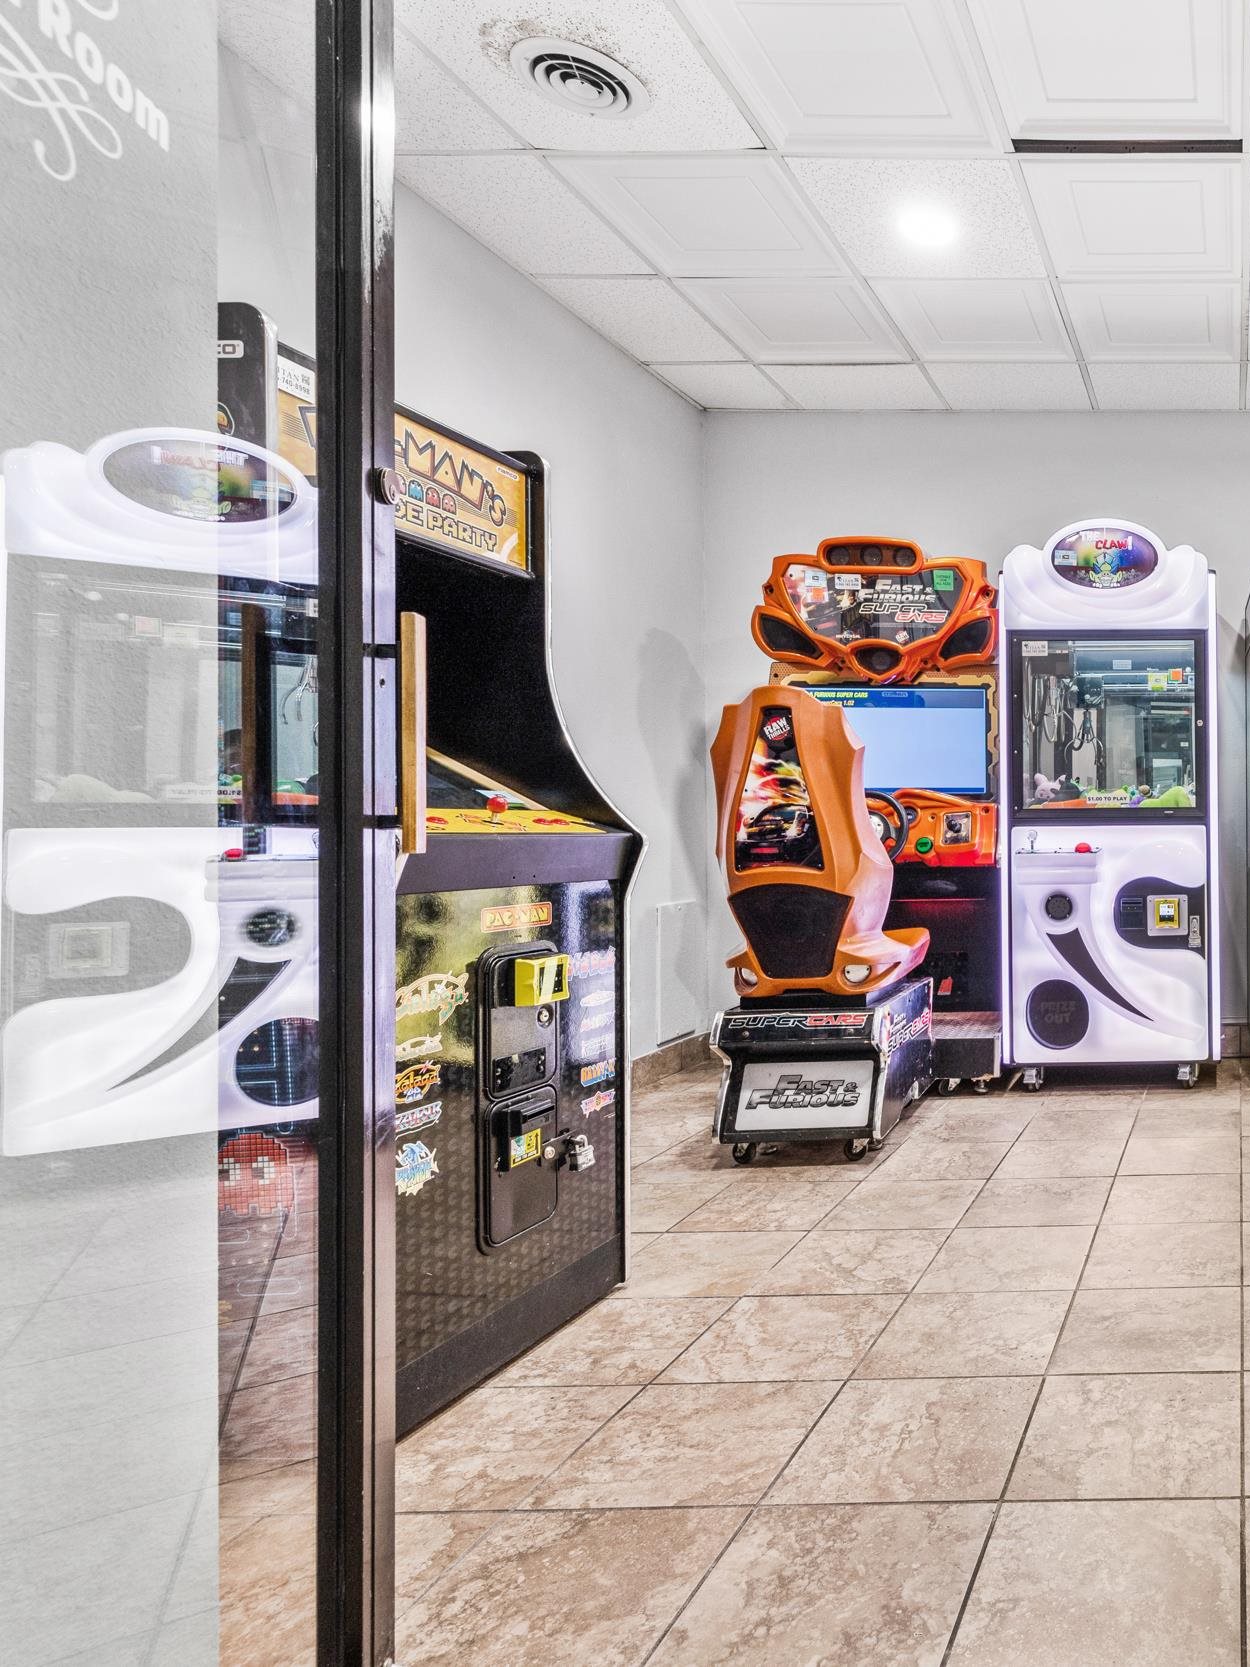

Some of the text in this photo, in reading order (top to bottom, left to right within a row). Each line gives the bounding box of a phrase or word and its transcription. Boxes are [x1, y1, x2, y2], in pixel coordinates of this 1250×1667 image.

[427, 508, 498, 553] PARTY
[1095, 536, 1133, 550] CLAW!
[874, 579, 924, 594] FAST
[857, 589, 936, 603] FURIOUS
[859, 602, 927, 614] SUPER
[895, 610, 949, 623] CARS
[763, 716, 788, 735] RAW
[1044, 1013, 1072, 1024] OUT
[776, 1074, 859, 1097] FAST &
[745, 1088, 861, 1110] FURIOUS
